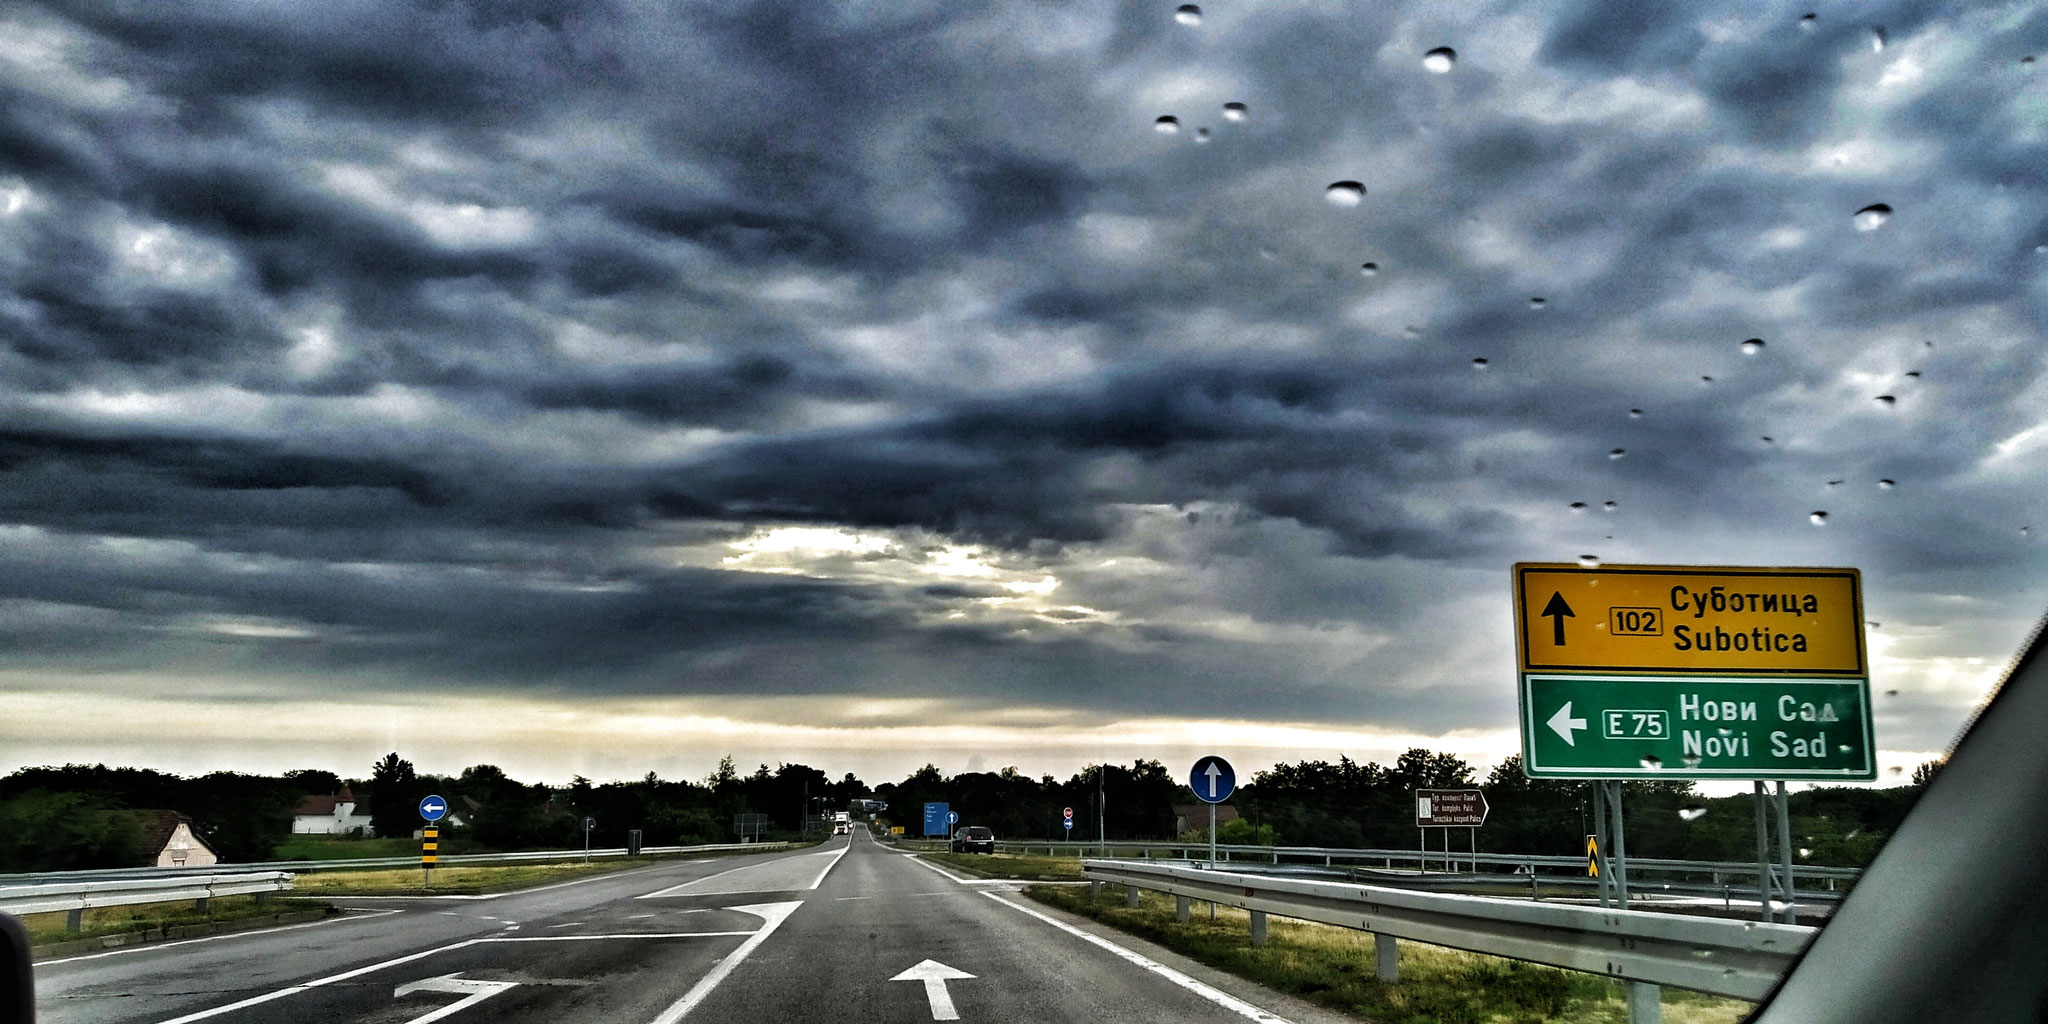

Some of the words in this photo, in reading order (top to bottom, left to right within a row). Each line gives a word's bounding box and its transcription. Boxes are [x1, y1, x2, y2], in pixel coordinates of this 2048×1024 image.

[1670, 585, 1818, 617] Суботица
[1615, 611, 1657, 632] 102
[1673, 625, 1808, 653] Subotica
[1680, 693, 1757, 722] Нови
[1778, 694, 1839, 722] Сад
[1609, 713, 1625, 735] E
[1631, 714, 1663, 736] 75
[1682, 730, 1750, 758] Novi
[1770, 731, 1827, 758] Sad
